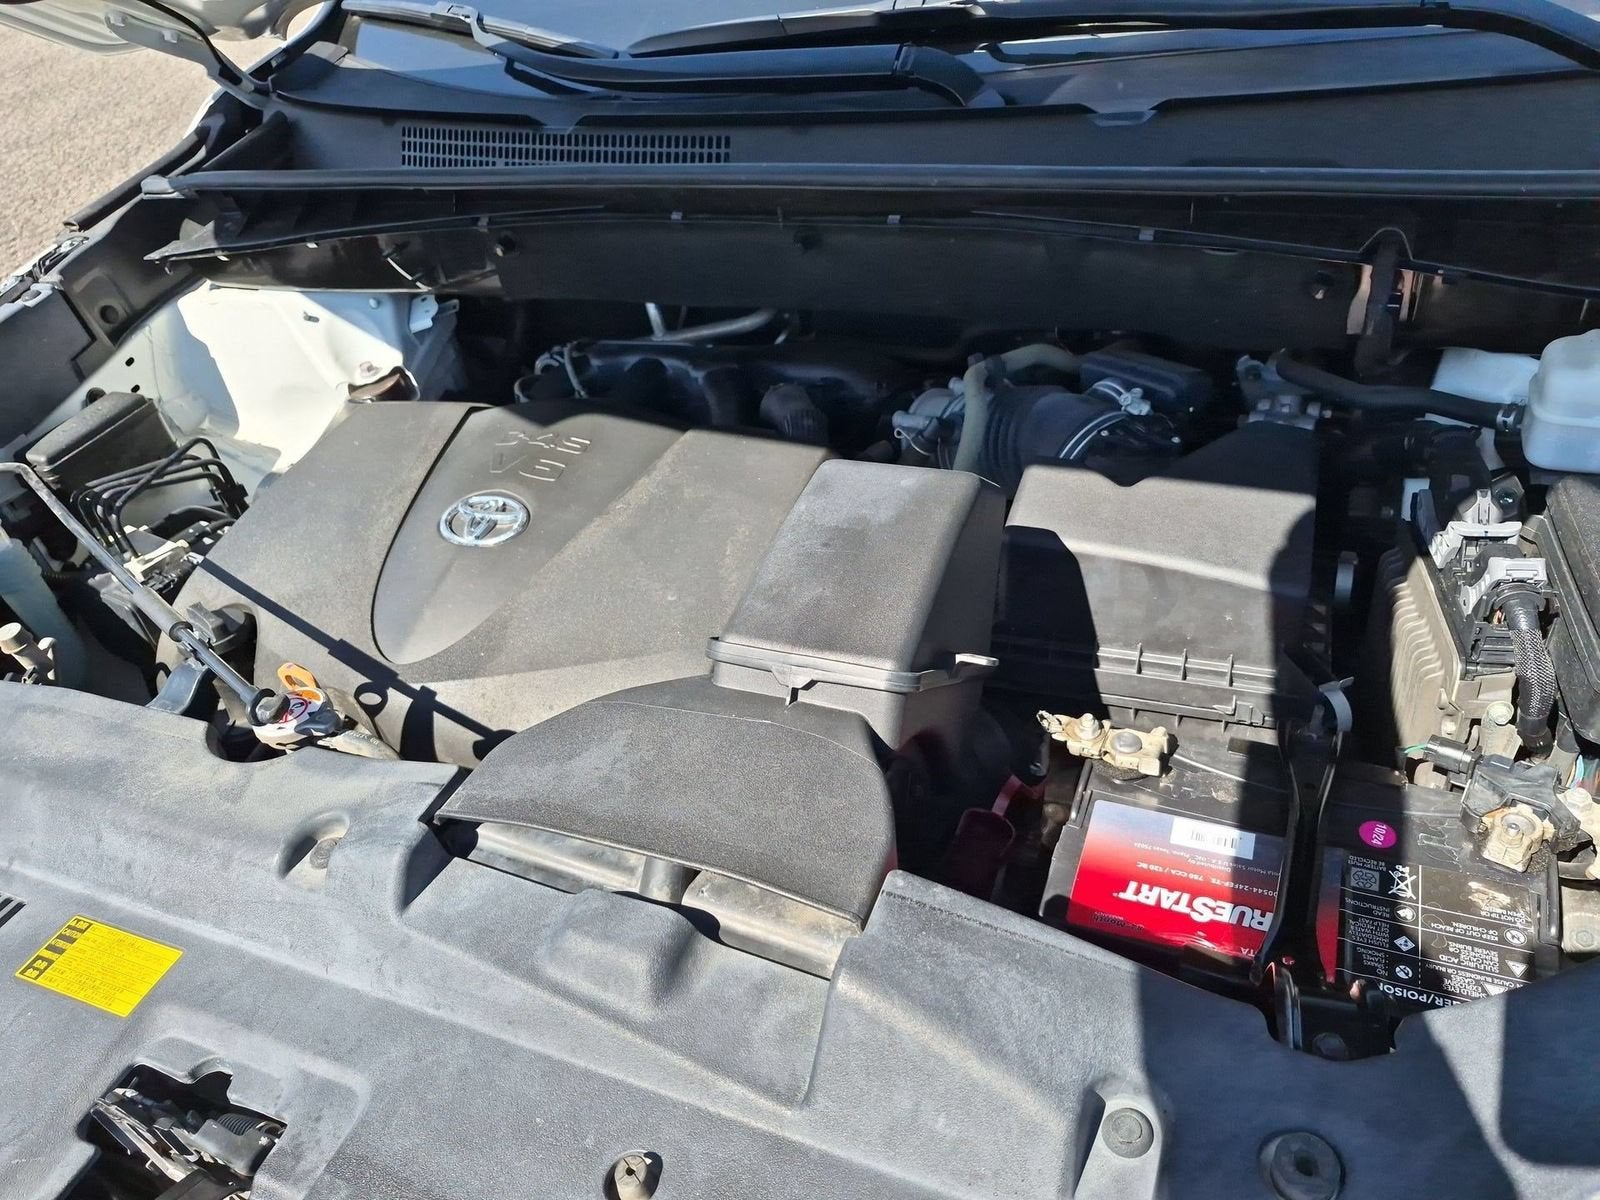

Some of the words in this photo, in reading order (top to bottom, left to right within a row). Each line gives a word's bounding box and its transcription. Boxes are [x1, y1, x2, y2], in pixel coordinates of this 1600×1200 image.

[1371, 824, 1387, 845] 10/24
[1118, 881, 1273, 932] RUESTART
[1344, 897, 1389, 912] INSTRUCTIONS
[1431, 922, 1453, 931] REACH
[1473, 946, 1497, 956] SEVERE
[1439, 953, 1458, 963] ACID
[1376, 967, 1388, 976] NO
[1460, 959, 1498, 973] SULFURIC
